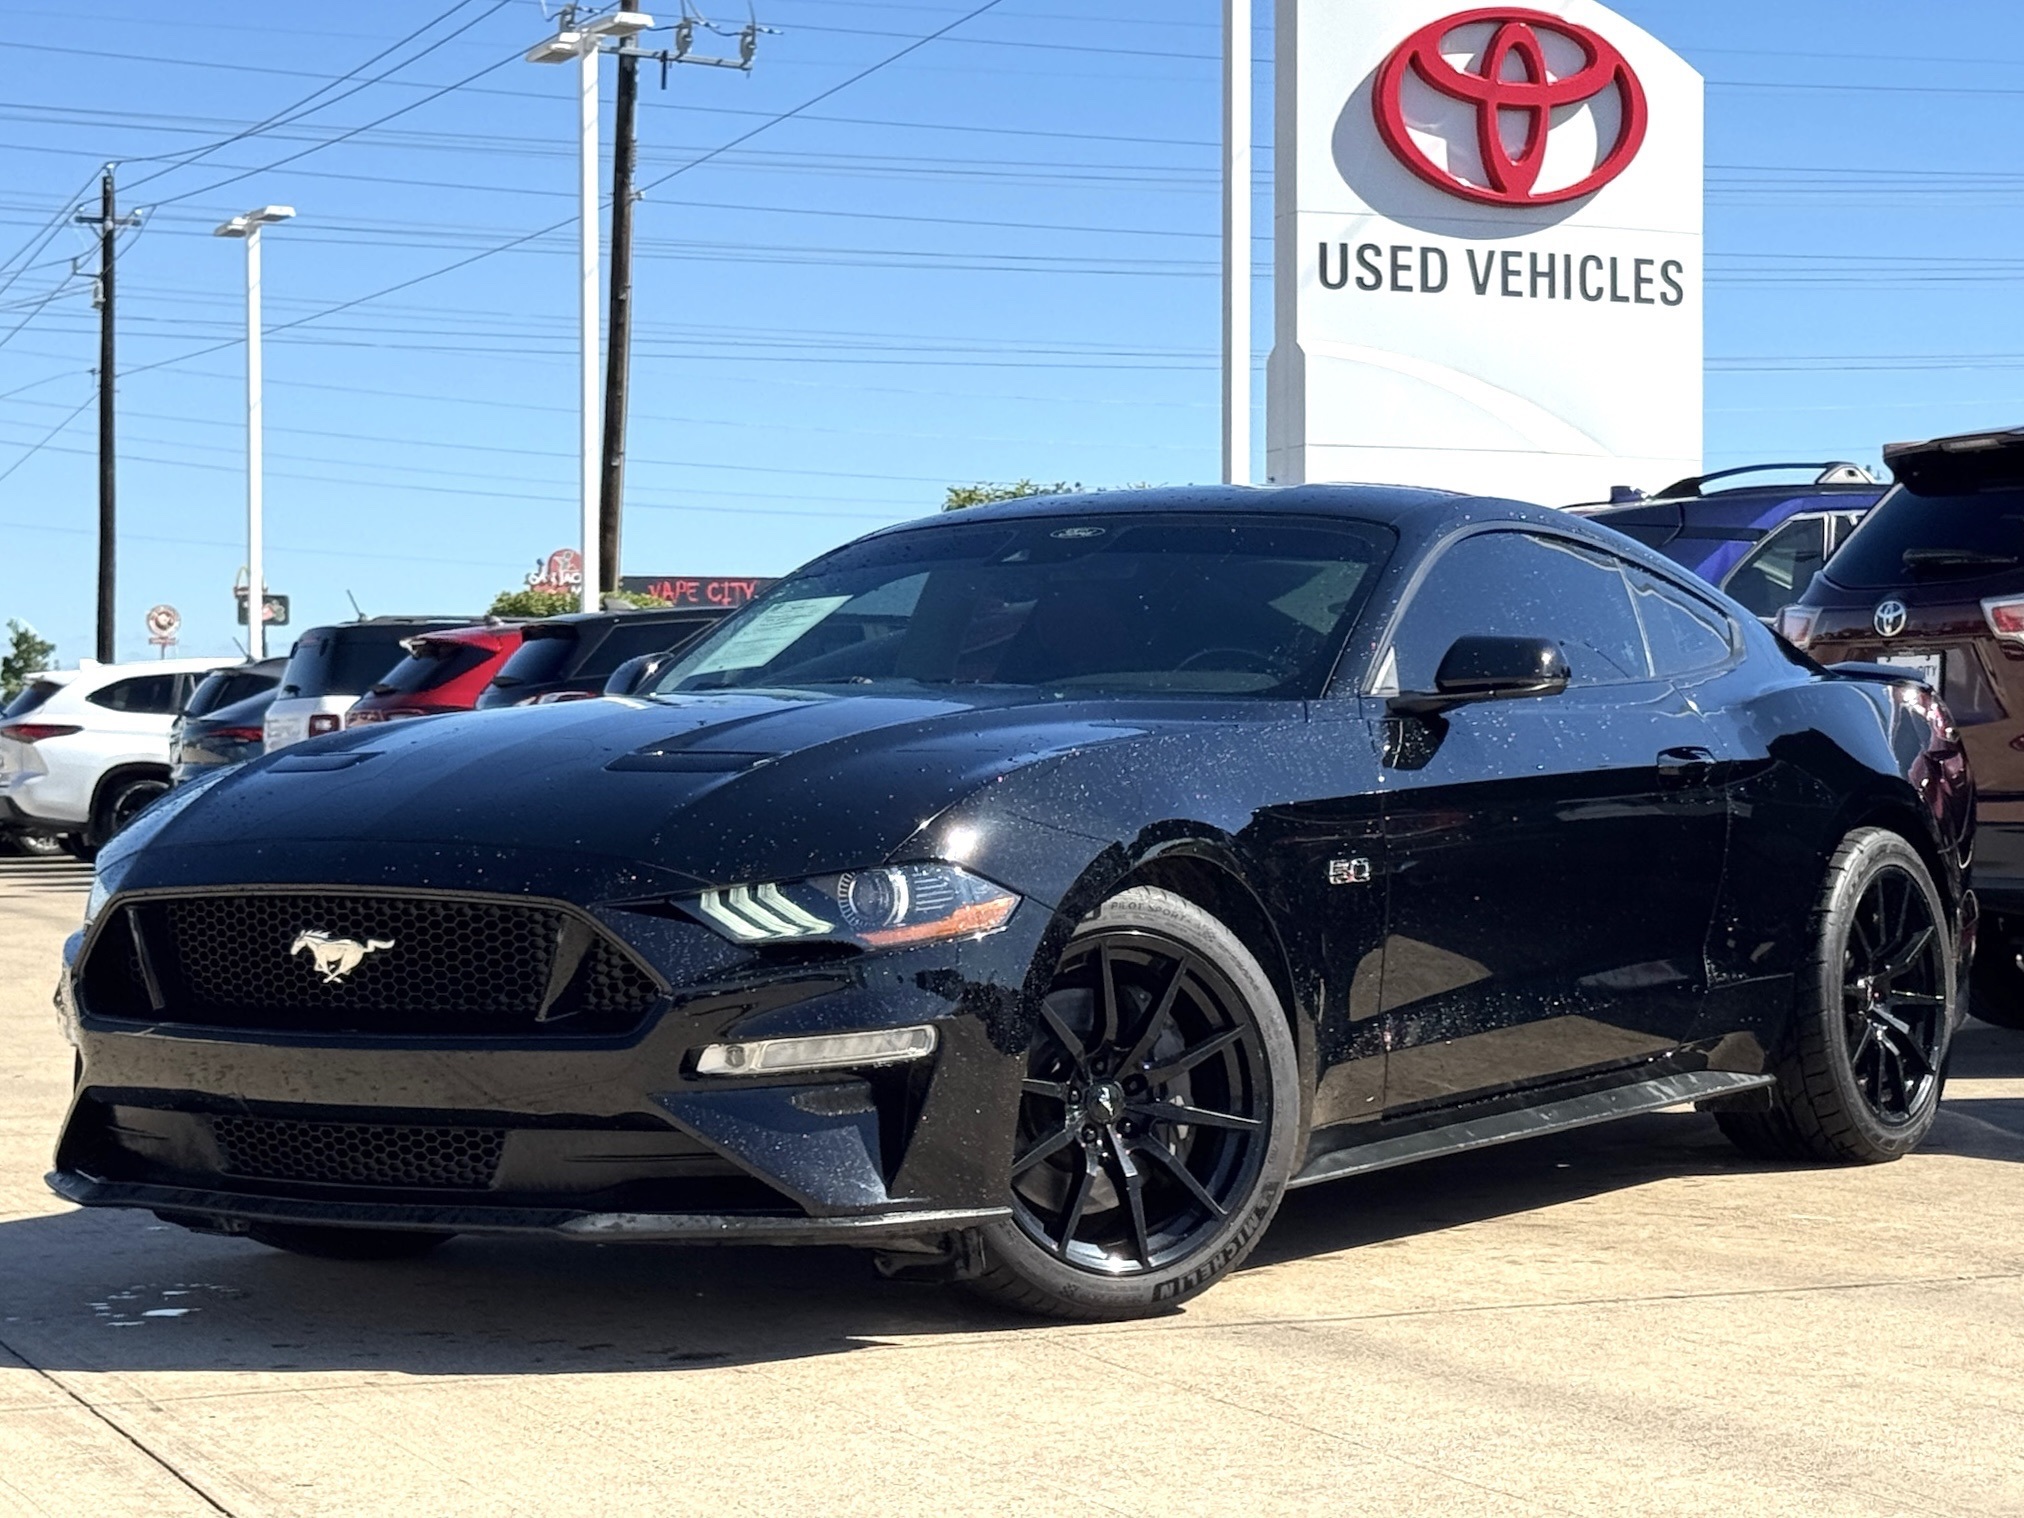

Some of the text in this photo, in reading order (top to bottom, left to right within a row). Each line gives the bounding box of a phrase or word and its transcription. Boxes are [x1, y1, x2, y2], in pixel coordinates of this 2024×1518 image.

[1317, 241, 1685, 307] USED VEHICLES
[648, 580, 758, 606] VAPE CITY
[1110, 901, 1144, 911] PILOT
[1159, 1214, 1260, 1301] MICHELIN
